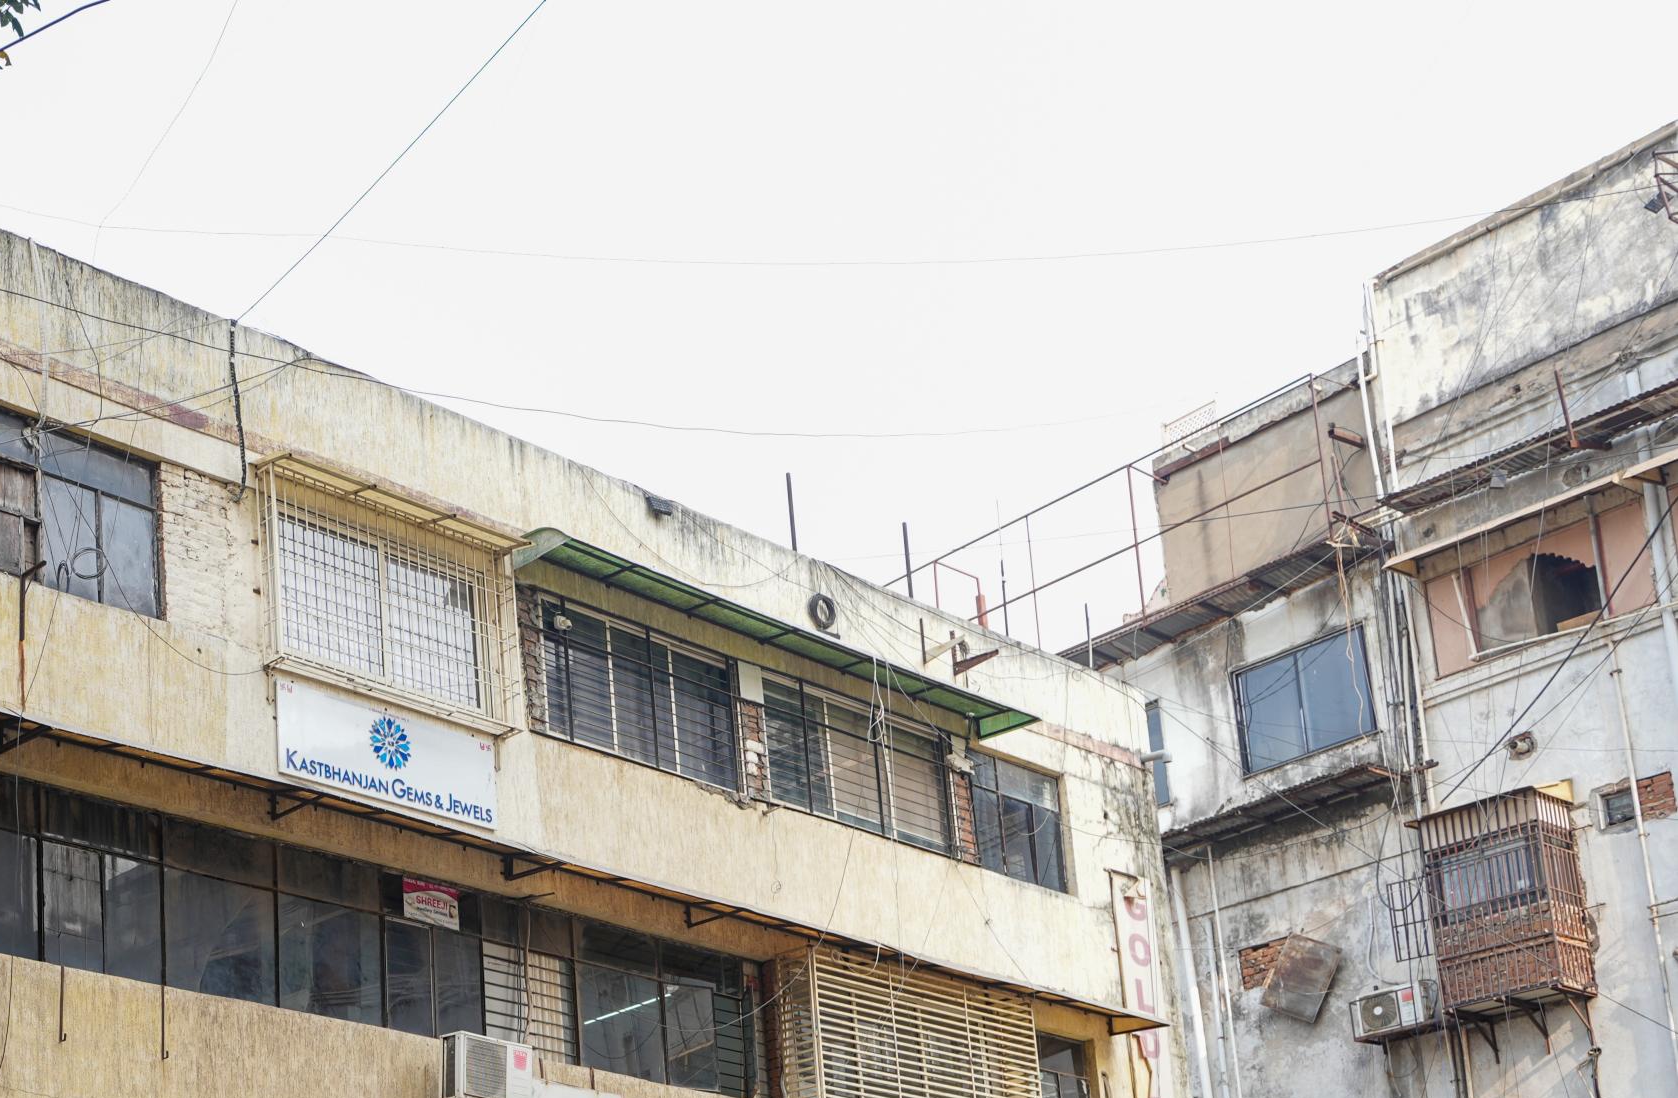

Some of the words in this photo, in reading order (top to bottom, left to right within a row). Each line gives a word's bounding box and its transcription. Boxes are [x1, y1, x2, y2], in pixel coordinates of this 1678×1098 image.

[286, 749, 388, 796] KASTBHANJAN
[392, 779, 433, 805] GEMS
[434, 795, 443, 810] &
[445, 793, 492, 823] JEWELS
[416, 896, 448, 910] SHREEJI
